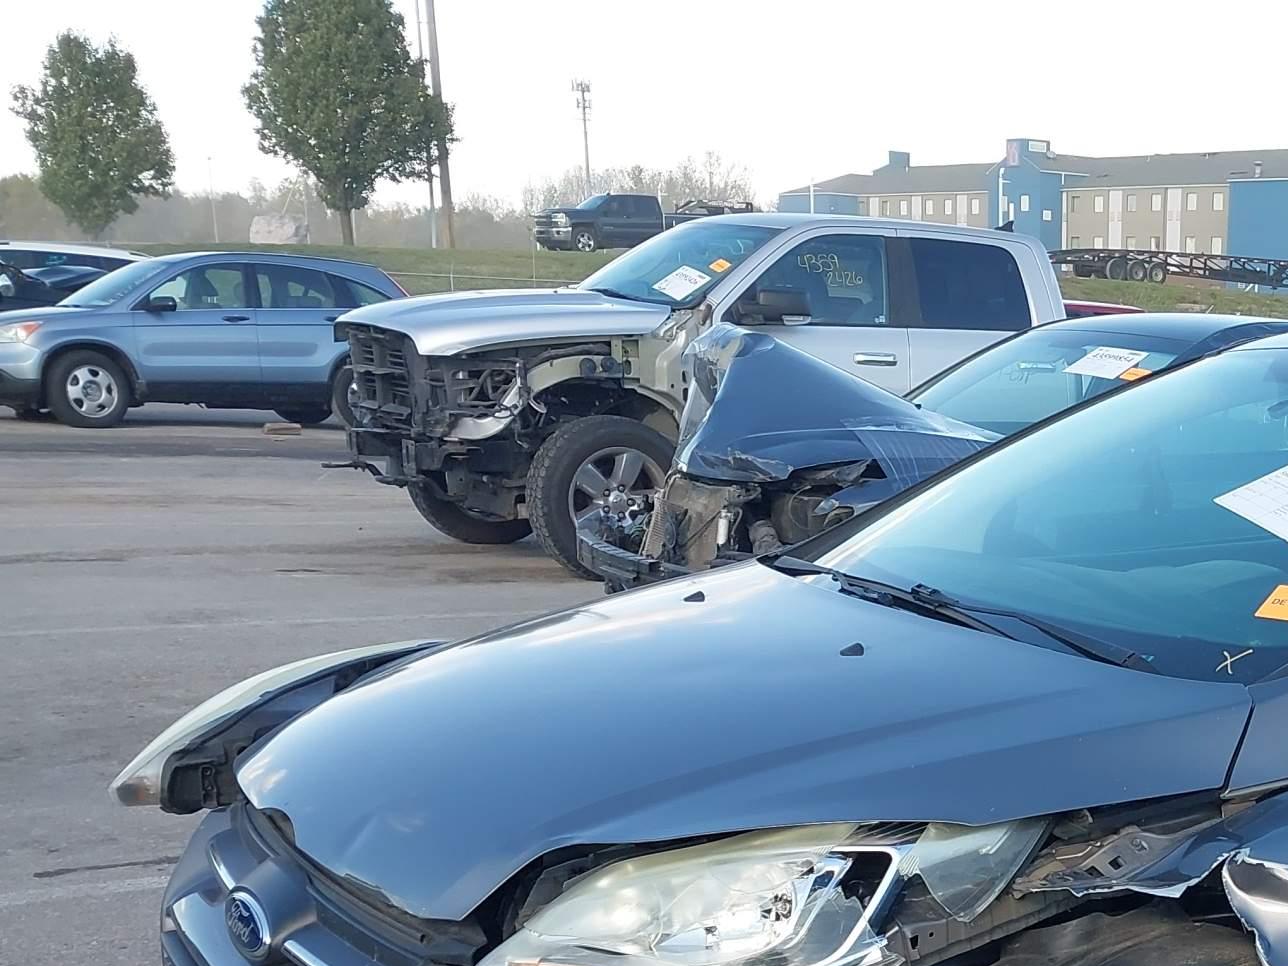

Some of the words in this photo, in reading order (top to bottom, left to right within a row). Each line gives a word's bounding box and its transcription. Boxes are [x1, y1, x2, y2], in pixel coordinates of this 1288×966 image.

[797, 253, 840, 273] 4359
[827, 271, 863, 288] 2426
[227, 900, 253, 943] Ford
